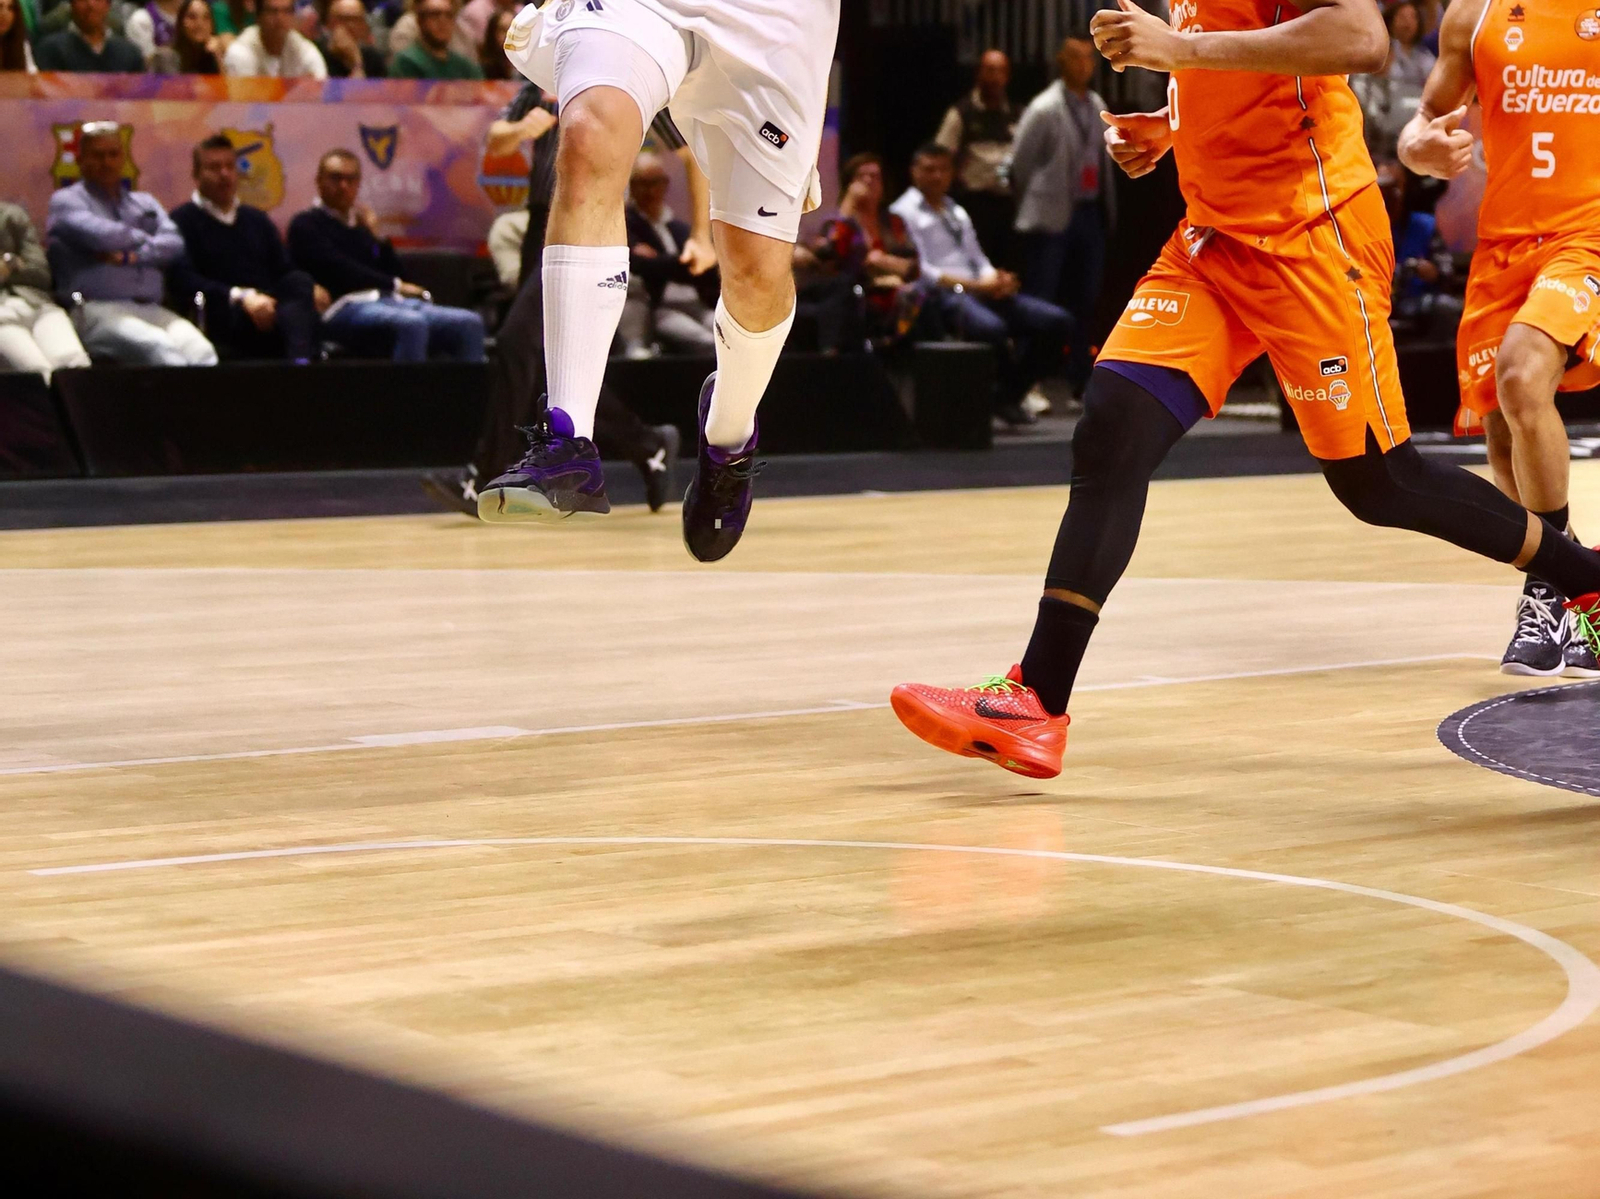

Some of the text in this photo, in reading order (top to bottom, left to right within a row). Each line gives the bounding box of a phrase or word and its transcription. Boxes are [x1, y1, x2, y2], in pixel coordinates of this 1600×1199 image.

[1502, 64, 1600, 88] Cultura de
[1502, 88, 1600, 114] Esfuerzo
[761, 128, 780, 144] acb
[1531, 132, 1556, 178] 5
[597, 281, 628, 291] adida
[1127, 297, 1178, 314] ULEVA
[1469, 345, 1498, 367] ULEV
[1323, 364, 1342, 375] acb
